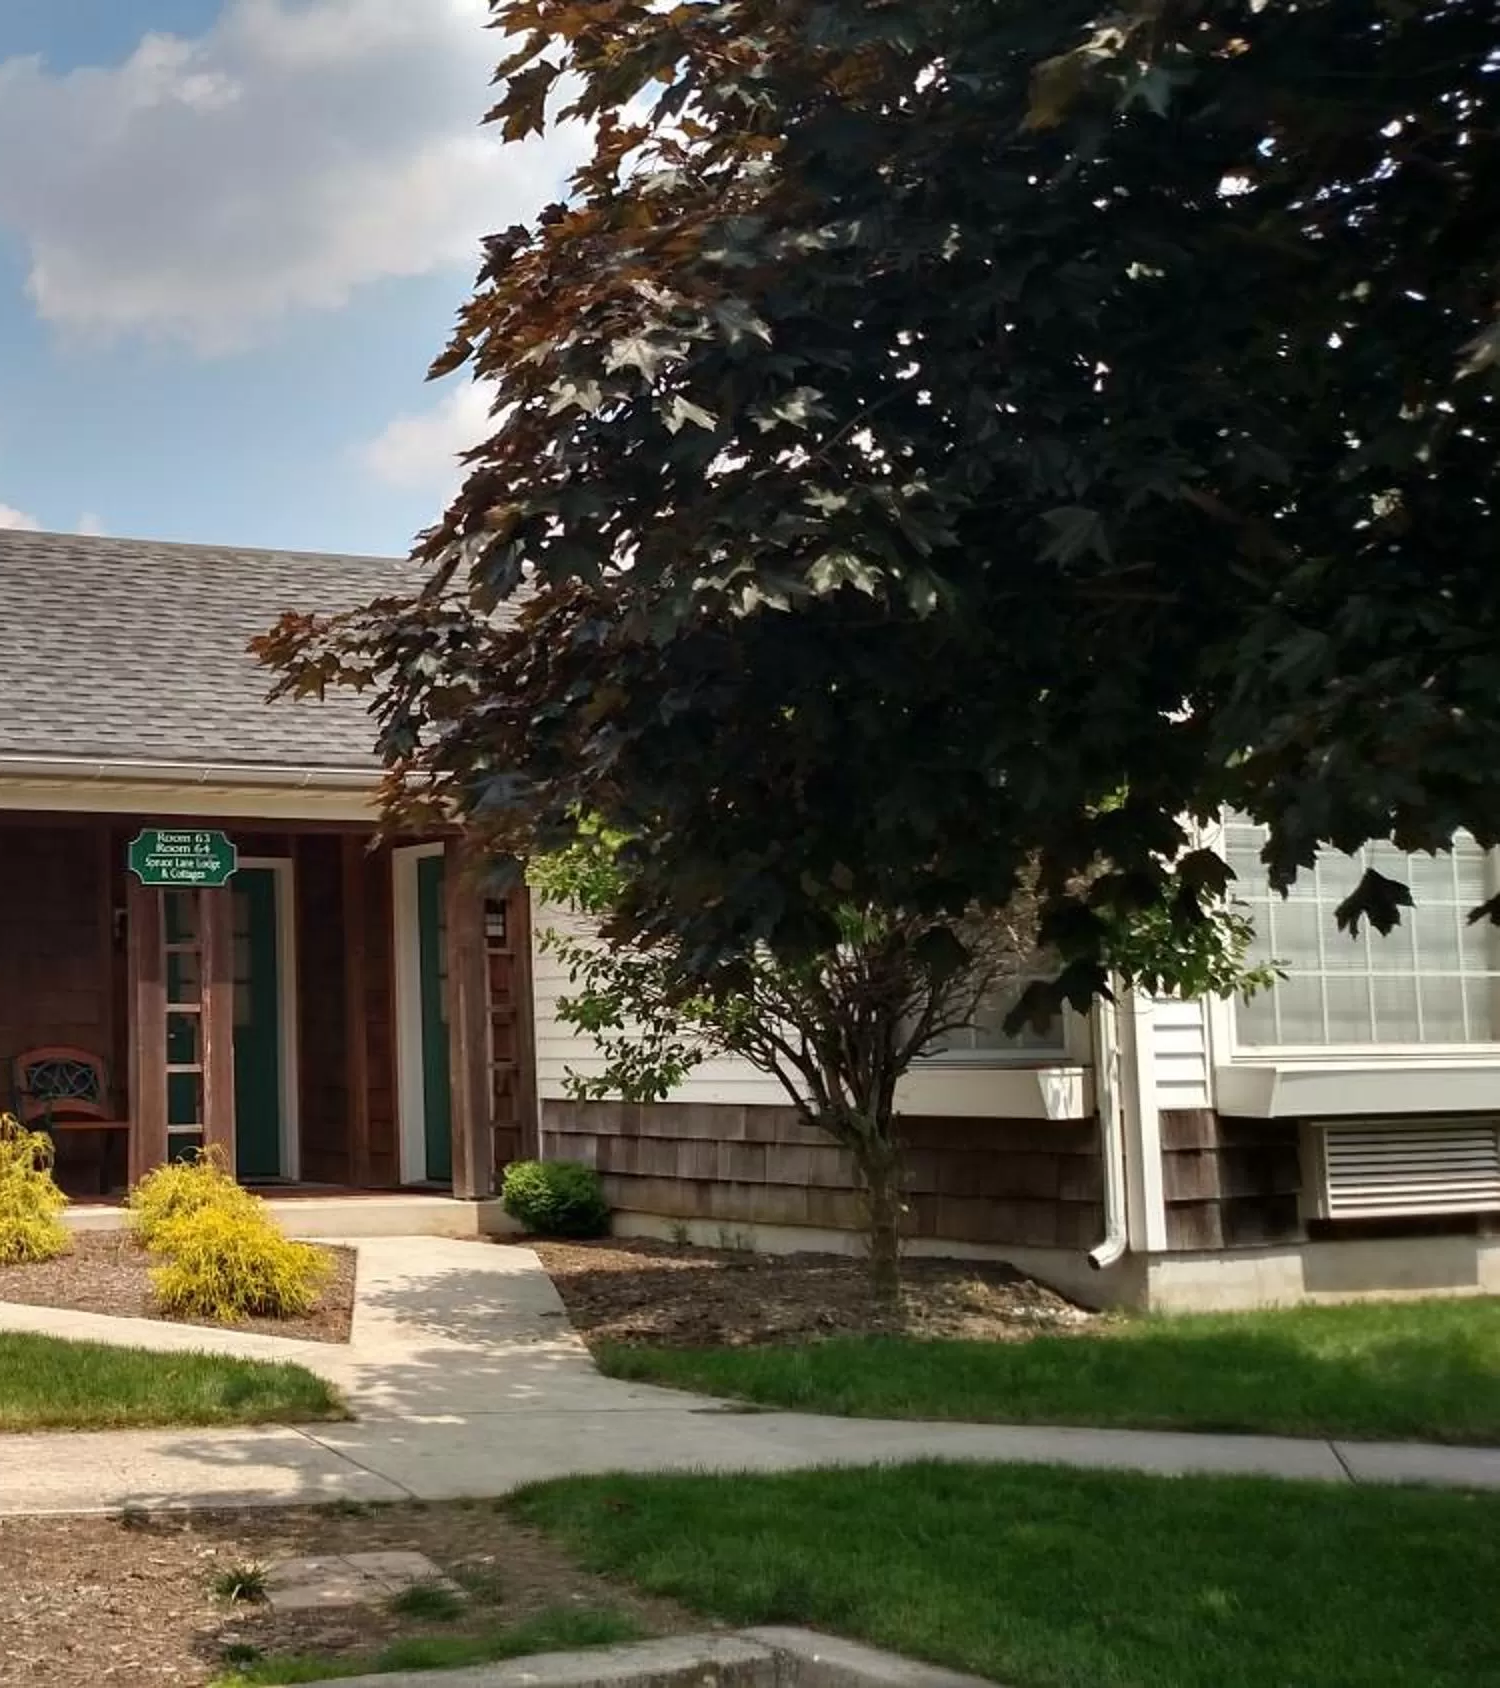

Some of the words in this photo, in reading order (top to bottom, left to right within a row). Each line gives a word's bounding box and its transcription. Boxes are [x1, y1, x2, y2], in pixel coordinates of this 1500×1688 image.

[157, 832, 191, 843] Room
[195, 833, 211, 843] 63
[156, 843, 191, 853] Room
[194, 843, 211, 853] 64
[145, 857, 173, 869] Spruce
[175, 857, 194, 868] Lane
[196, 858, 221, 872] Lodge
[161, 868, 169, 879] &
[170, 868, 206, 882] Cottages
